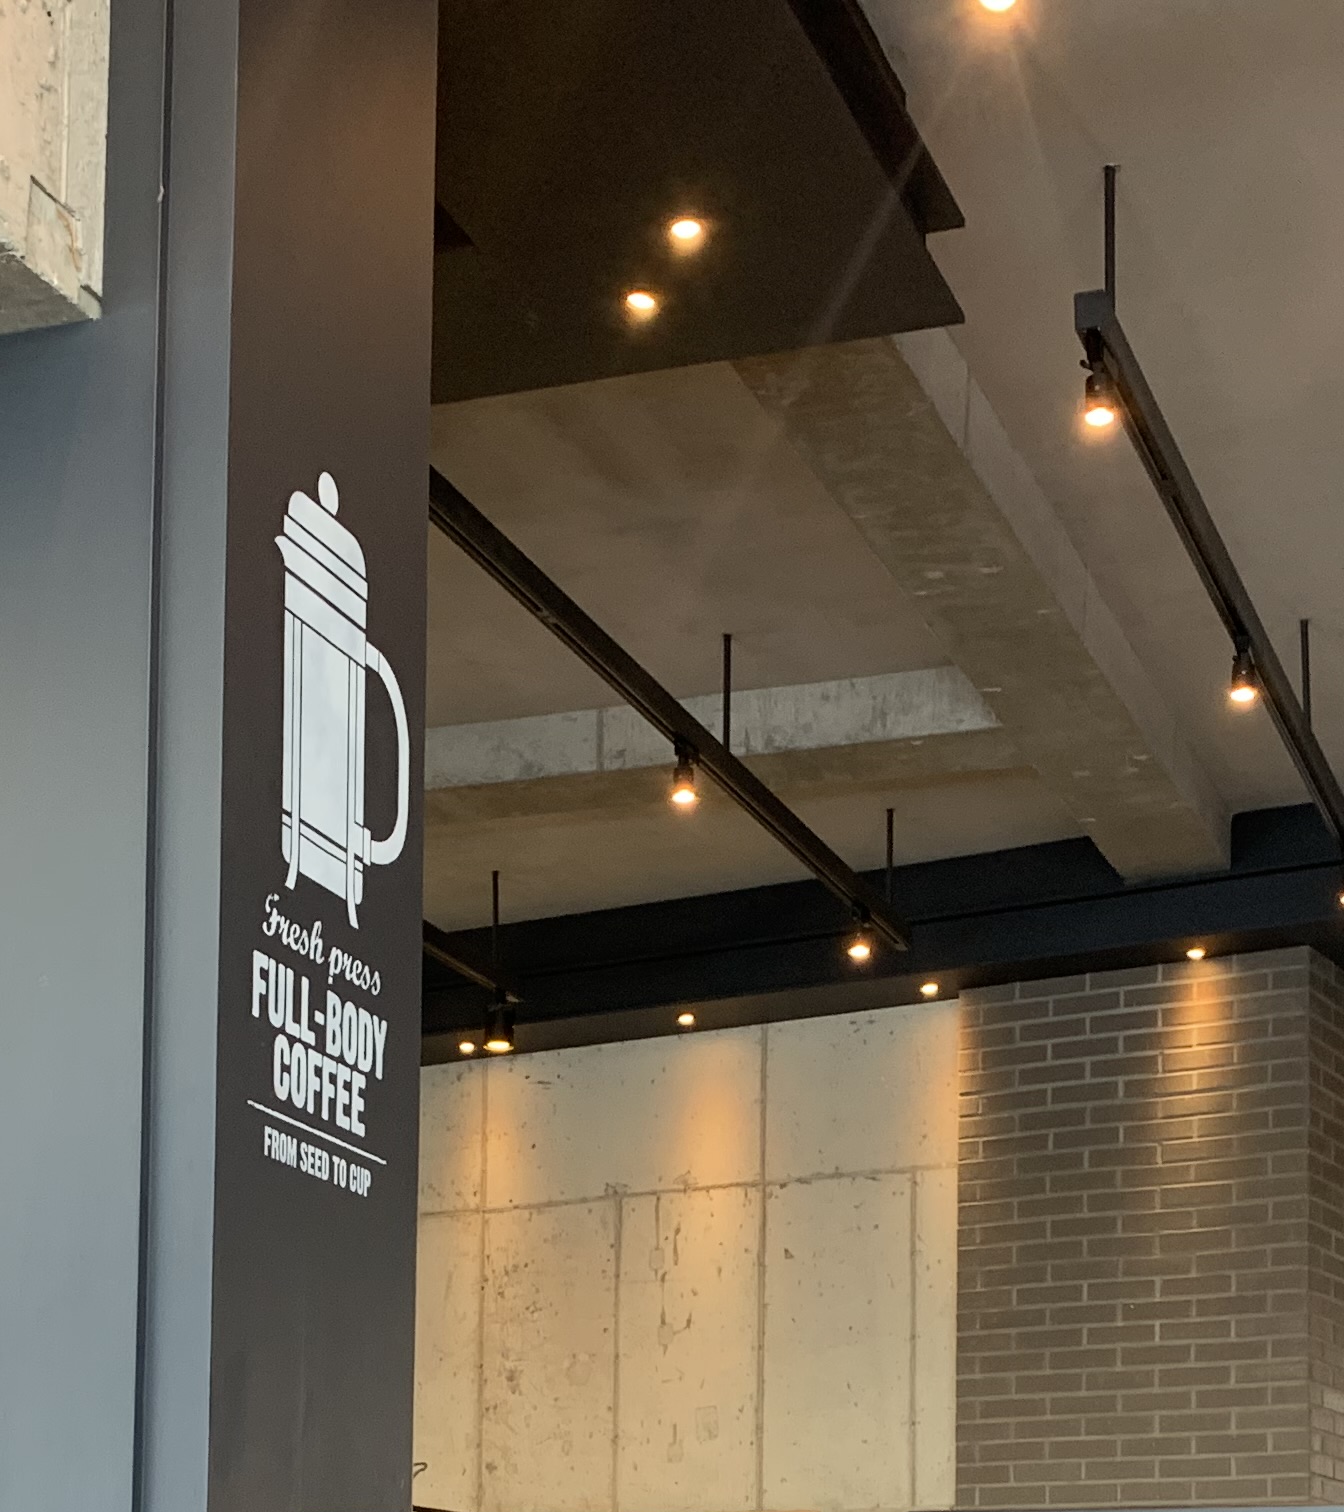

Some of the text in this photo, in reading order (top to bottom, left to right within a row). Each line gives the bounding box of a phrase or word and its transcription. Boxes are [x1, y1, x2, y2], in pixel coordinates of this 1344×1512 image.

[262, 893, 382, 996] Fresh press
[251, 949, 389, 1081] FULL-BODY
[273, 1033, 367, 1138] COFFEE
[264, 1125, 372, 1198] FROM SEED TO CUP
